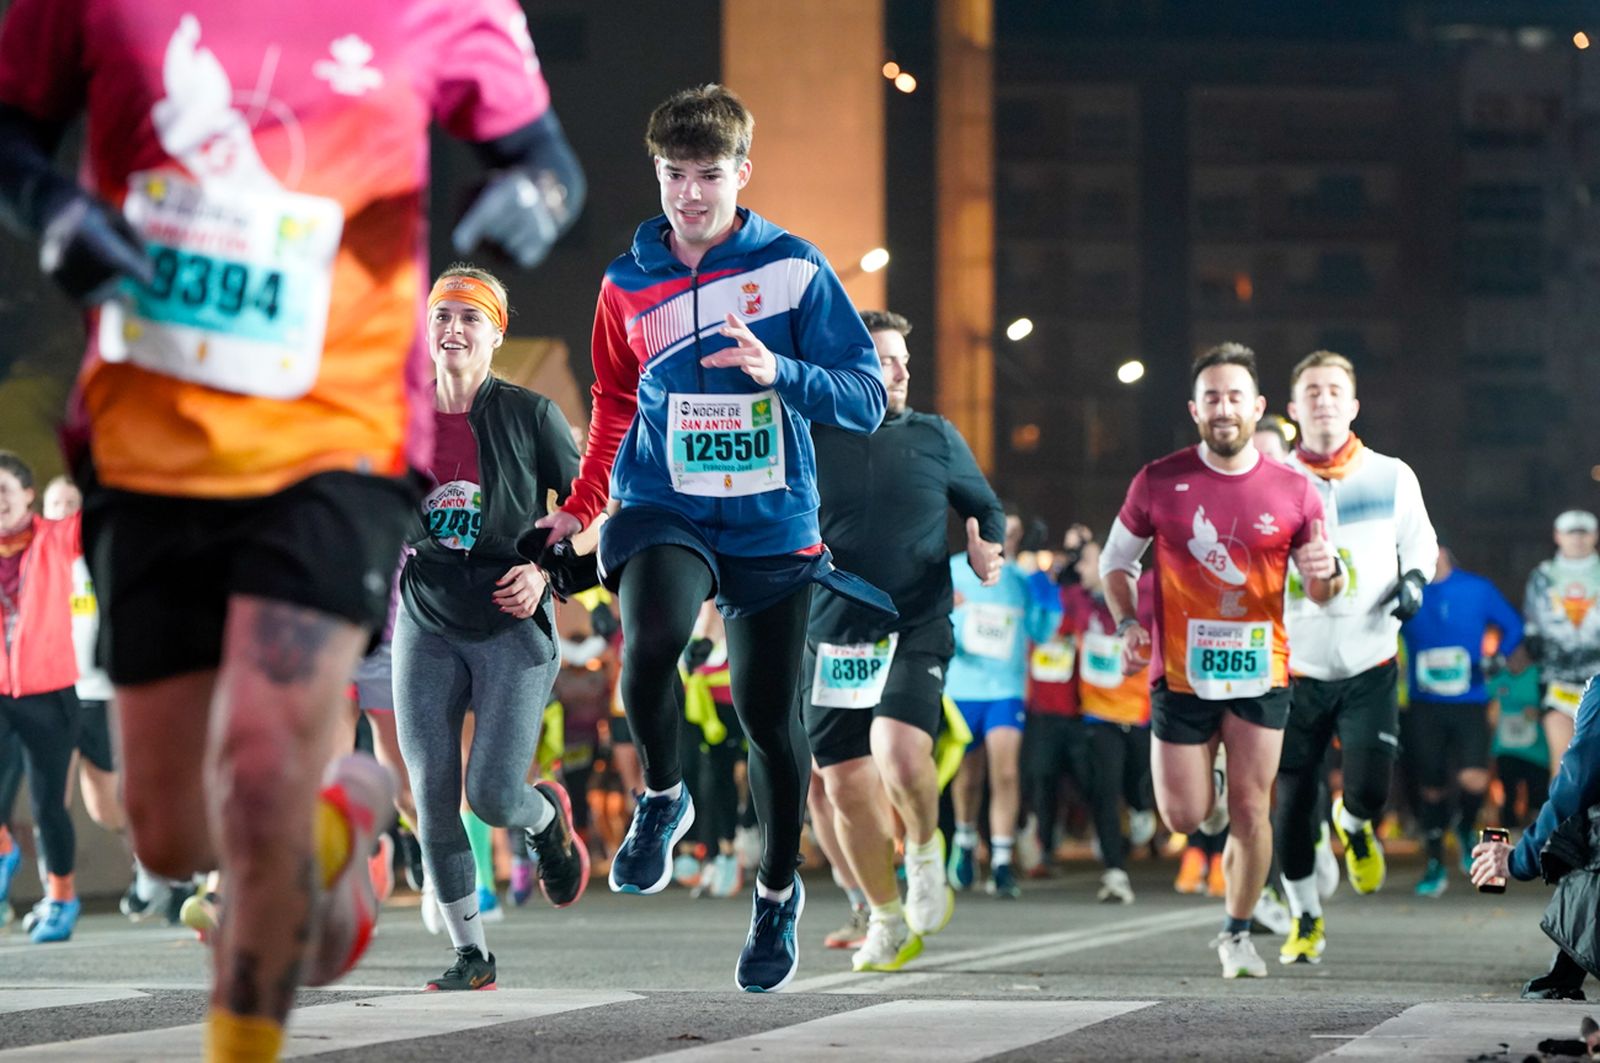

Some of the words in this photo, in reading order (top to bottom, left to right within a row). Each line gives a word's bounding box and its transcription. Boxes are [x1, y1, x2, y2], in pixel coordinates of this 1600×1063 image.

[149, 248, 281, 320] 9394
[681, 419, 701, 430] SAN
[703, 417, 742, 430] ANTÓN
[692, 406, 725, 417] NOCHE
[728, 406, 742, 417] DE
[681, 428, 770, 462] 12550
[1205, 549, 1227, 572] 43
[1201, 648, 1257, 673] 8365
